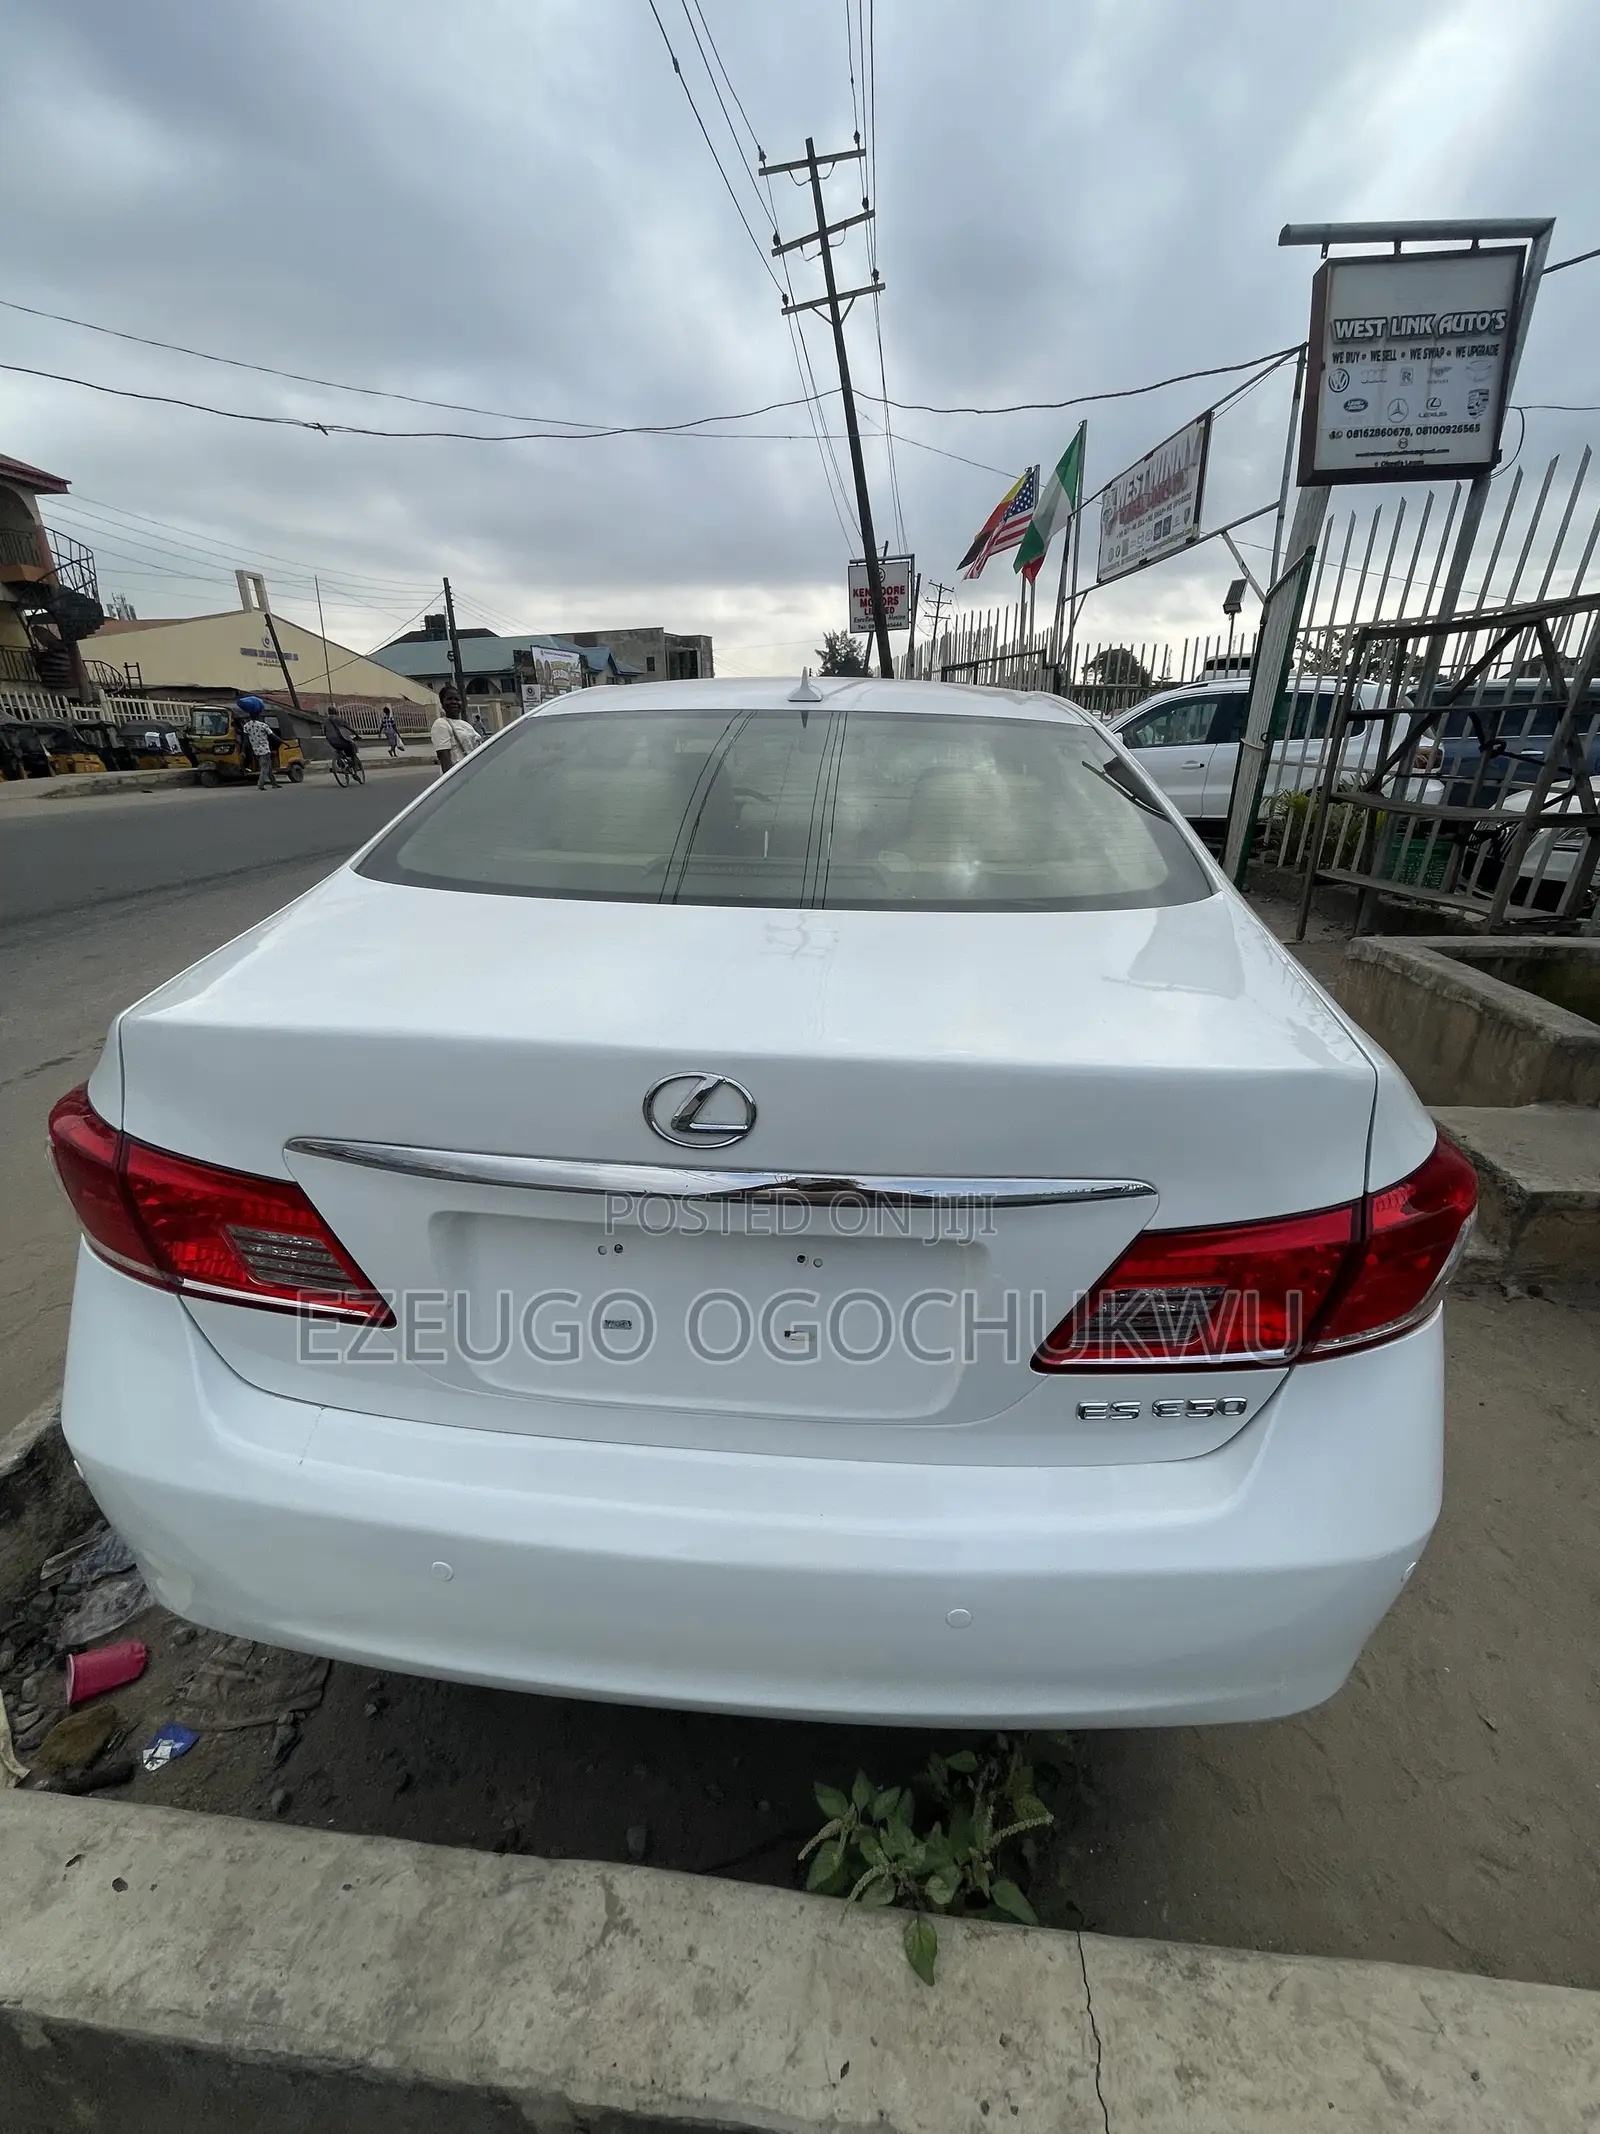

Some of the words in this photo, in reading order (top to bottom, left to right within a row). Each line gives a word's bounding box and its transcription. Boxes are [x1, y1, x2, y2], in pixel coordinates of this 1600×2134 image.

[1334, 318, 1387, 339] WEST
[1391, 315, 1435, 337] LINK
[1439, 311, 1506, 335] AUTO'S
[1332, 352, 1344, 364] WE
[1345, 351, 1360, 363] BUY
[1370, 350, 1381, 362] WE
[1382, 349, 1396, 361] SELL
[1409, 348, 1421, 360] WE
[1422, 347, 1445, 359] SWAP
[853, 585, 905, 598] KENOORE
[860, 596, 899, 607] MOORS
[864, 606, 895, 615] LIED
[1076, 1401, 1142, 1420] ES
